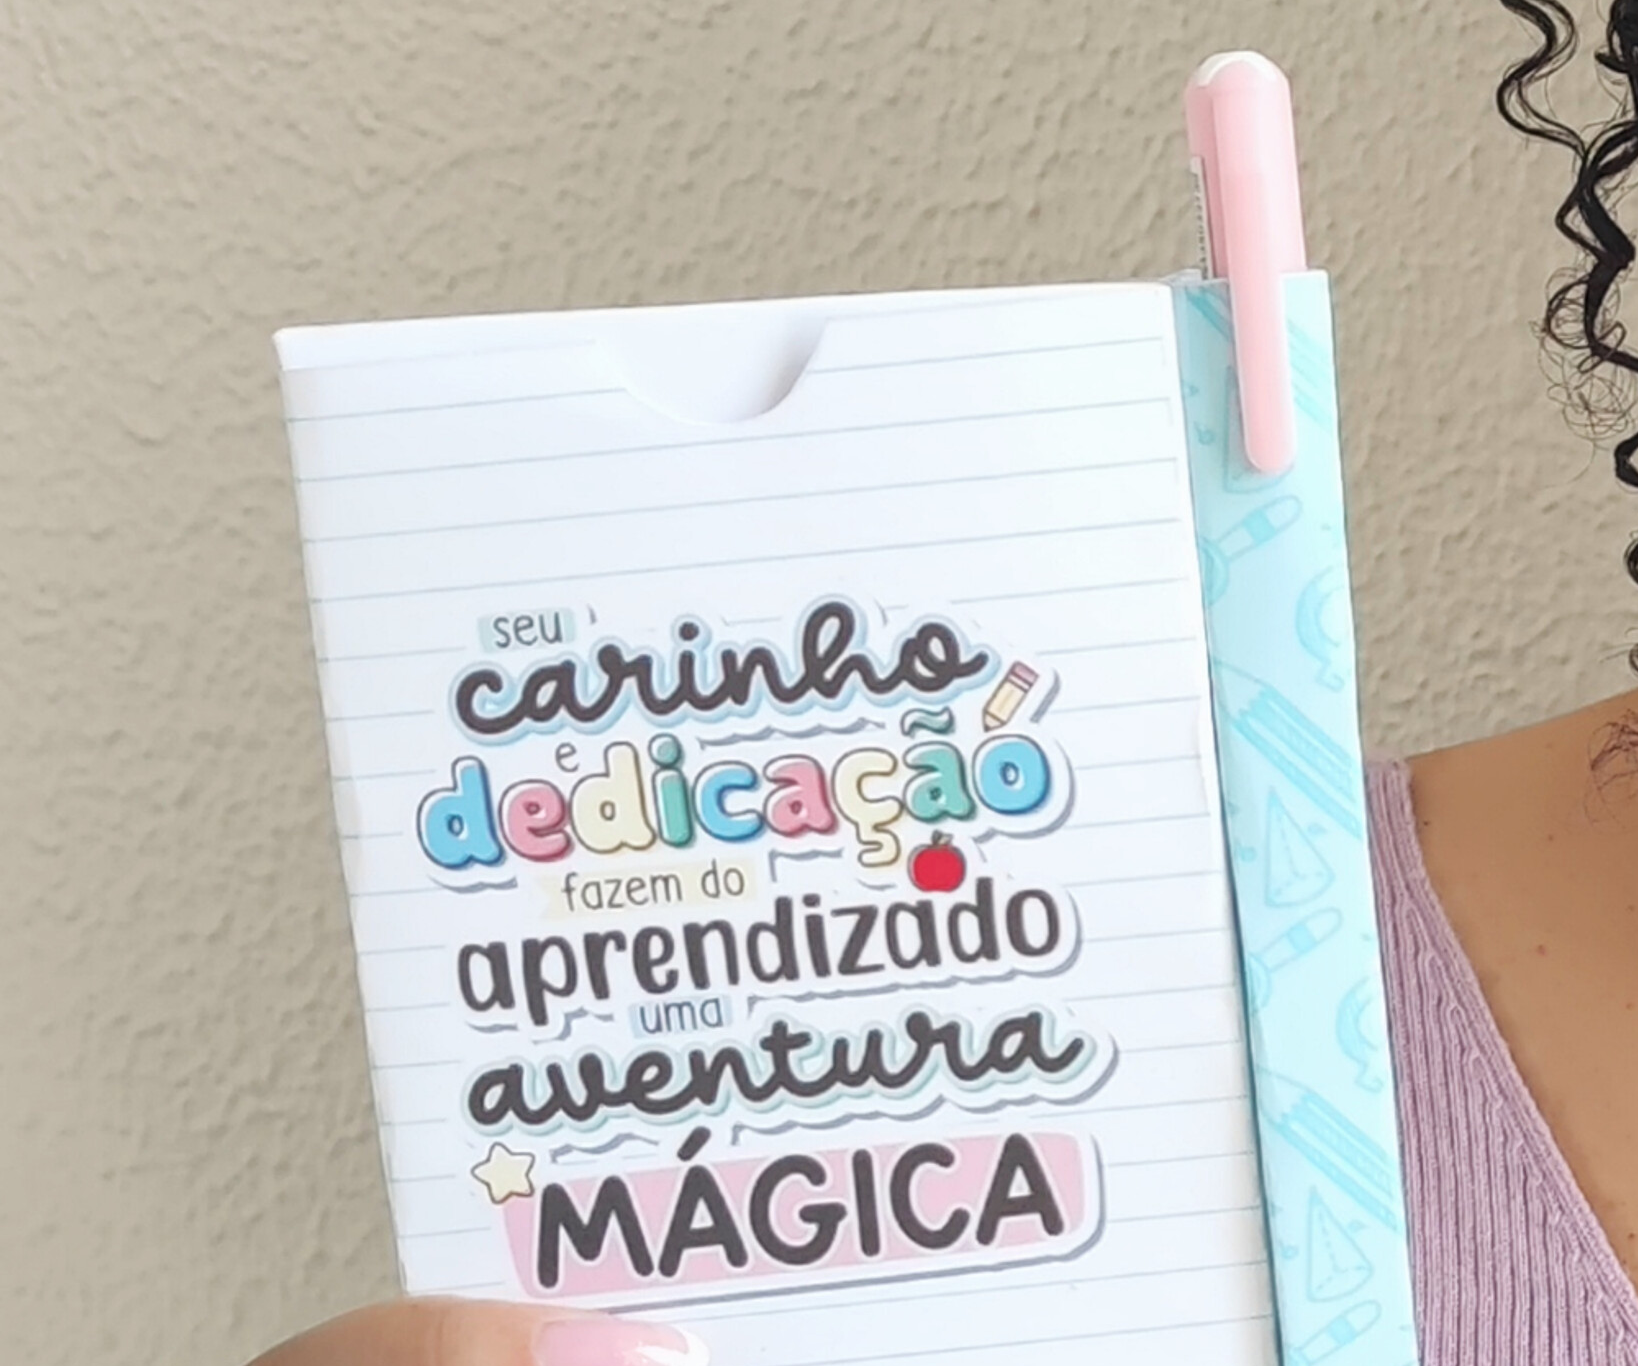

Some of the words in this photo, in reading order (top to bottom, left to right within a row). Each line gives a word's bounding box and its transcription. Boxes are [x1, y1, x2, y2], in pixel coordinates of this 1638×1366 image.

[455, 601, 989, 735] carinho
[492, 608, 563, 648] seu
[416, 708, 1053, 869] dedicação
[554, 742, 579, 773] e
[561, 866, 684, 913] fazem
[700, 860, 746, 898] do
[457, 877, 1061, 1027] aprendizado
[467, 1010, 1085, 1126] aventura
[638, 995, 724, 1035] uma
[536, 1125, 1066, 1289] MÁGICA
